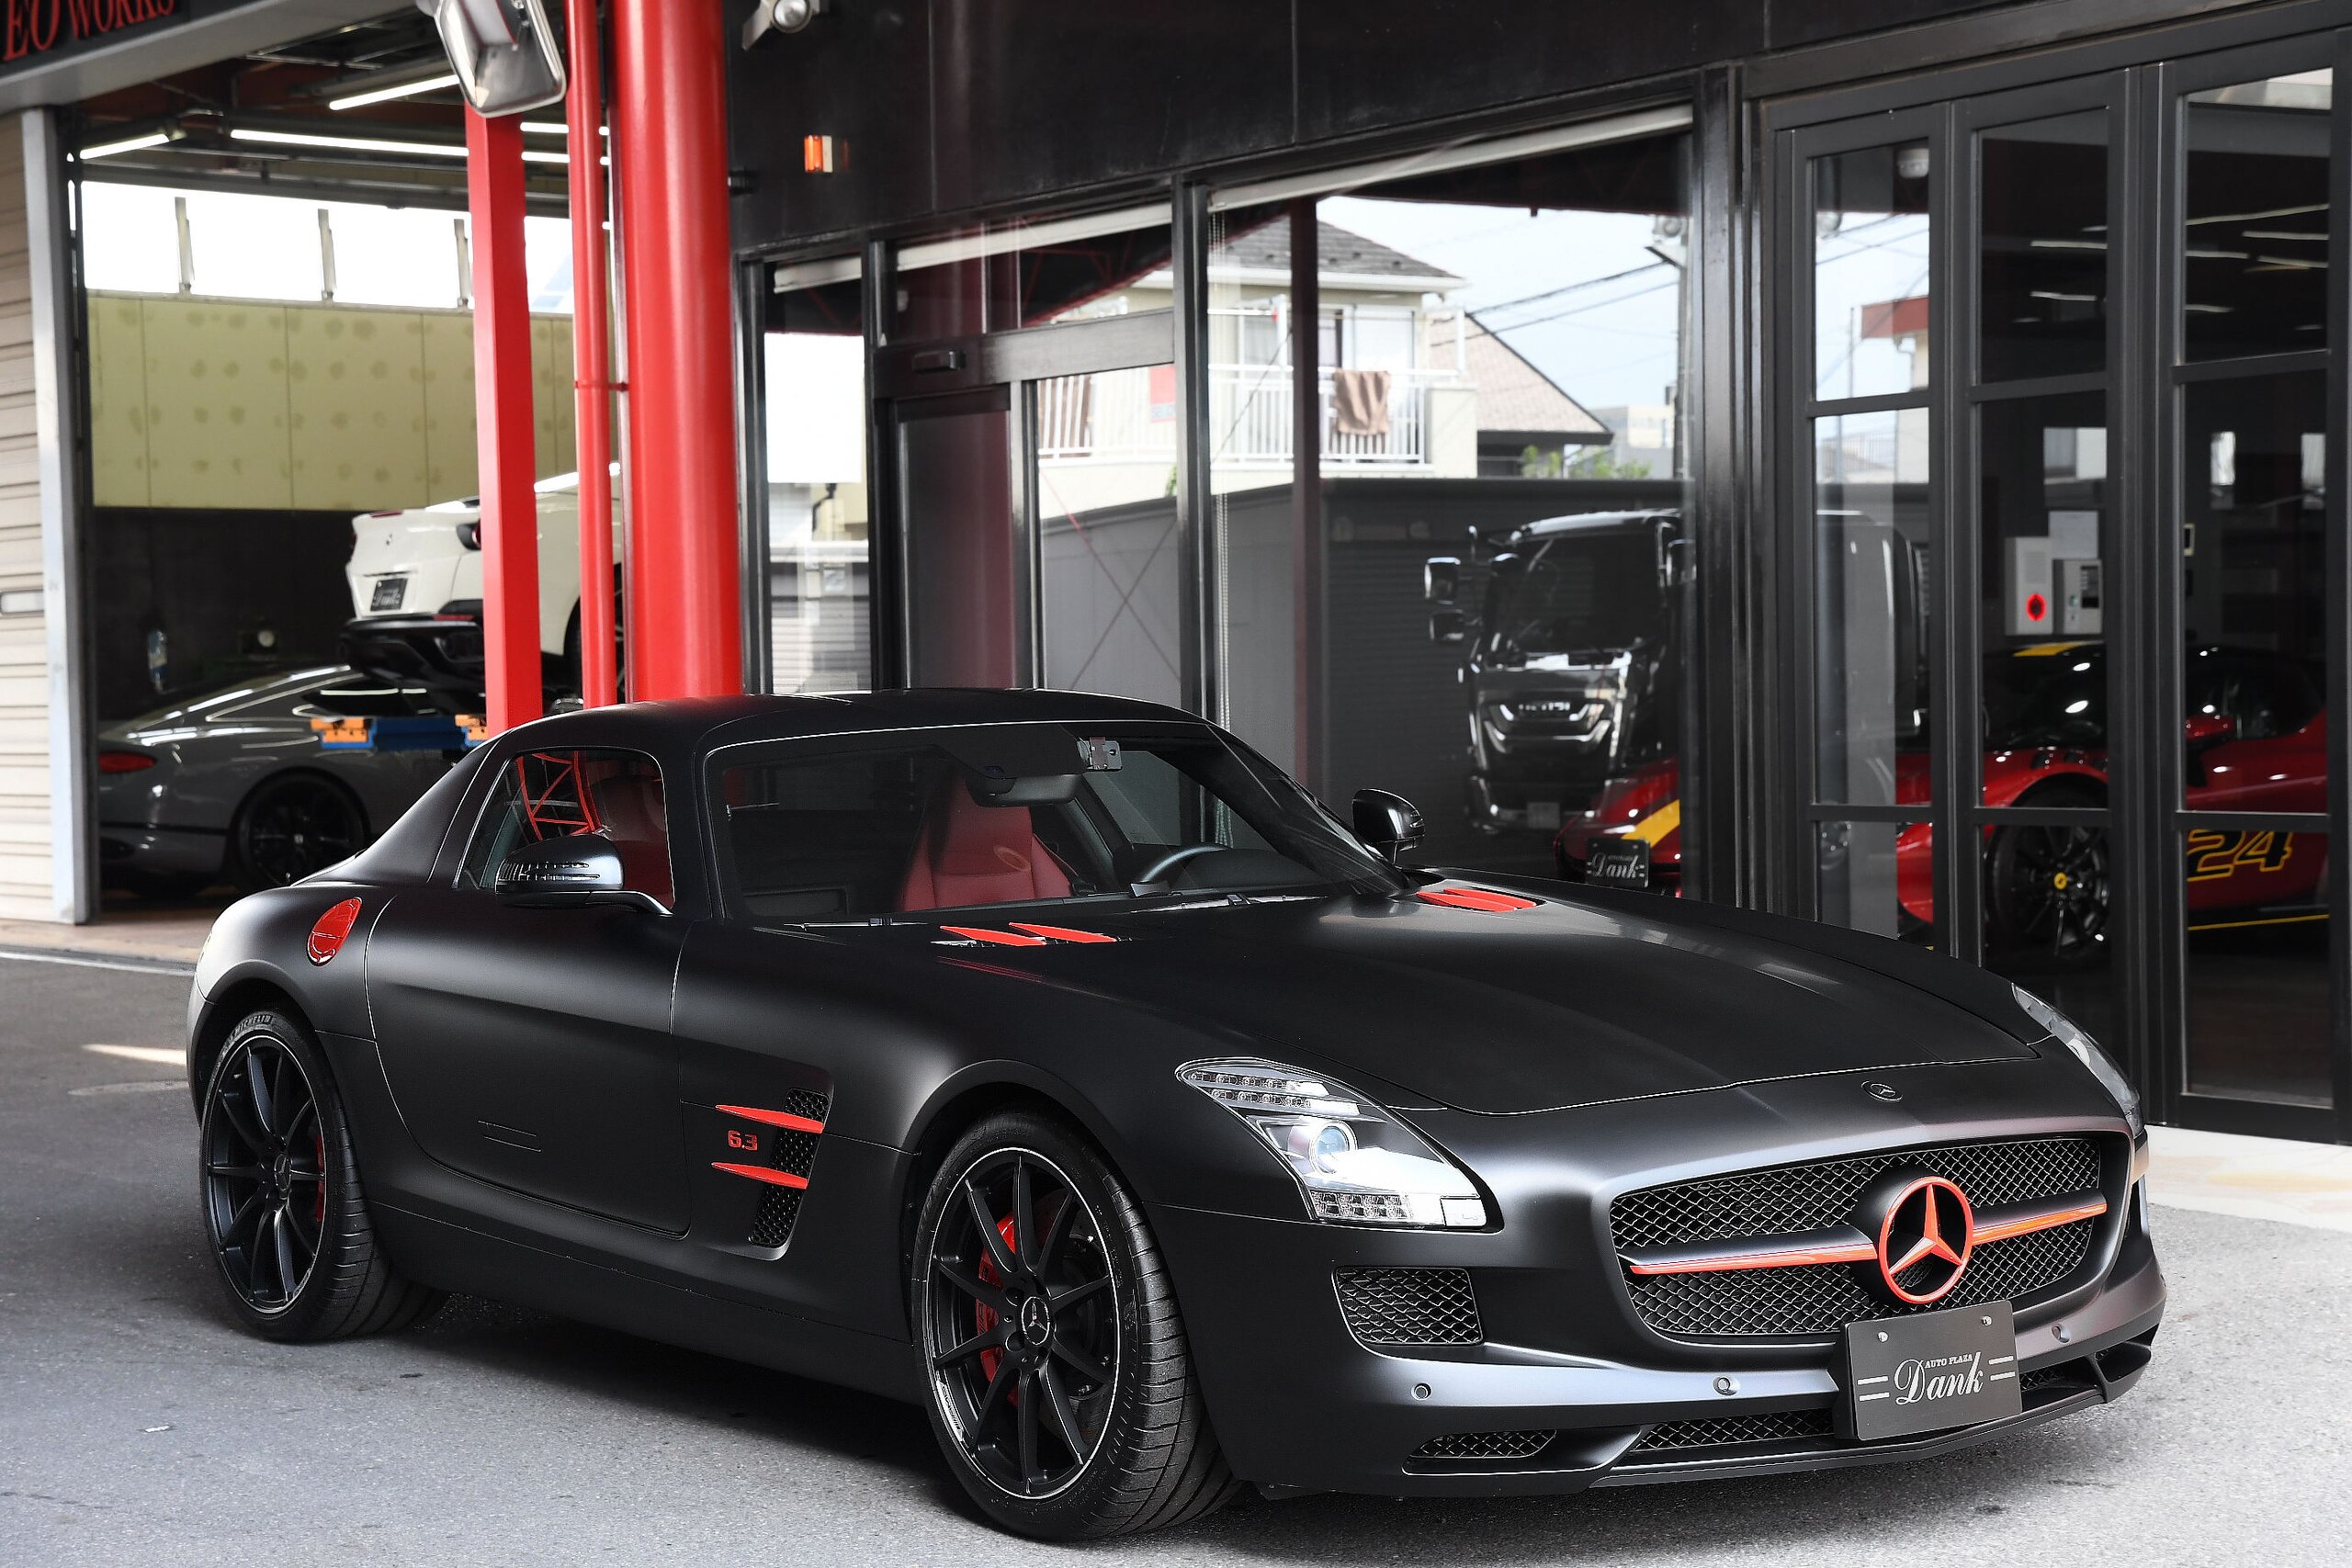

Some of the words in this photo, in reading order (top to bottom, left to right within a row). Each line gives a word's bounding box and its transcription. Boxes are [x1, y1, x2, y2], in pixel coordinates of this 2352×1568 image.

[2187, 829, 2292, 882] 24
[728, 1130, 758, 1151] 6.3
[1894, 1351, 1984, 1405] Dank
[1925, 1358, 1947, 1369] AUTO
[1948, 1353, 1973, 1365] PLAZA
